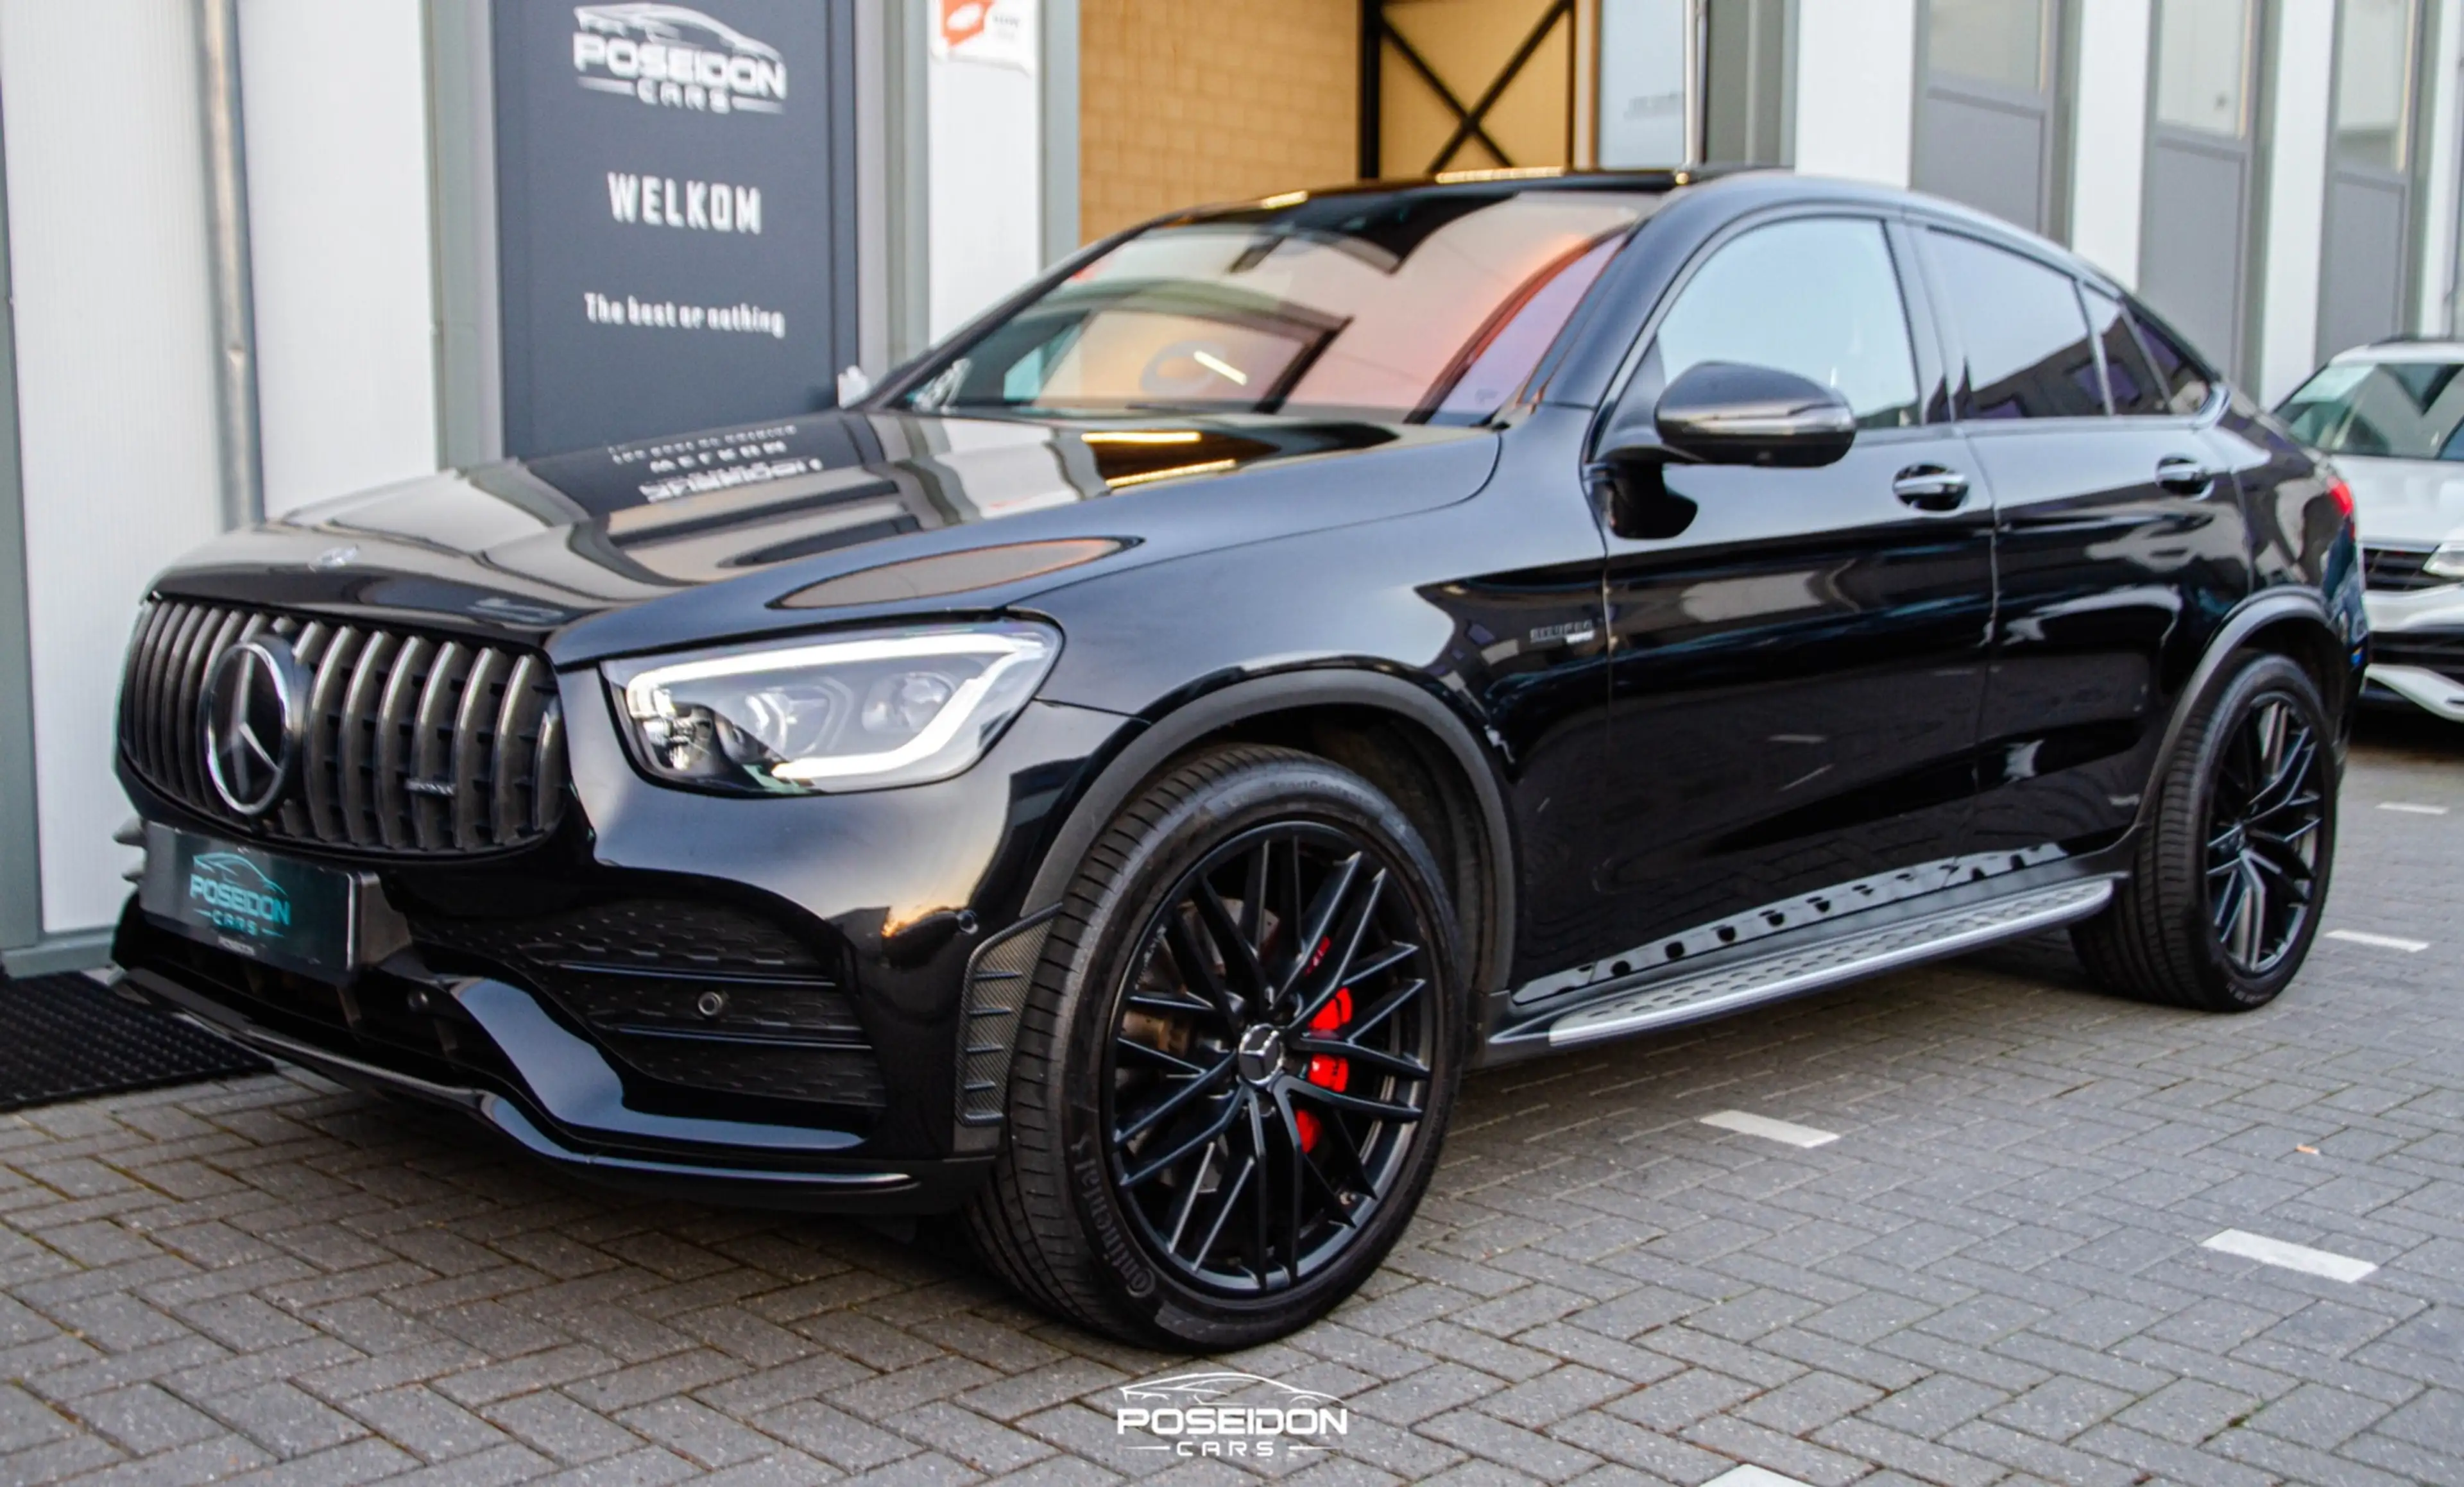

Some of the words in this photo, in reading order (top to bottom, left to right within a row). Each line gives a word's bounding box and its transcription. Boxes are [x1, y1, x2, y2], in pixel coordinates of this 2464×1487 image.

[573, 31, 787, 99] POSEIDON
[637, 78, 730, 114] CARS
[607, 171, 762, 235] WELKOM
[584, 292, 626, 325] The
[628, 294, 676, 328] best
[680, 305, 705, 330] or
[708, 302, 786, 340] nothing
[189, 873, 291, 927] POSEIDON
[212, 908, 258, 937] CARS
[1074, 1157, 1156, 1298] Continental
